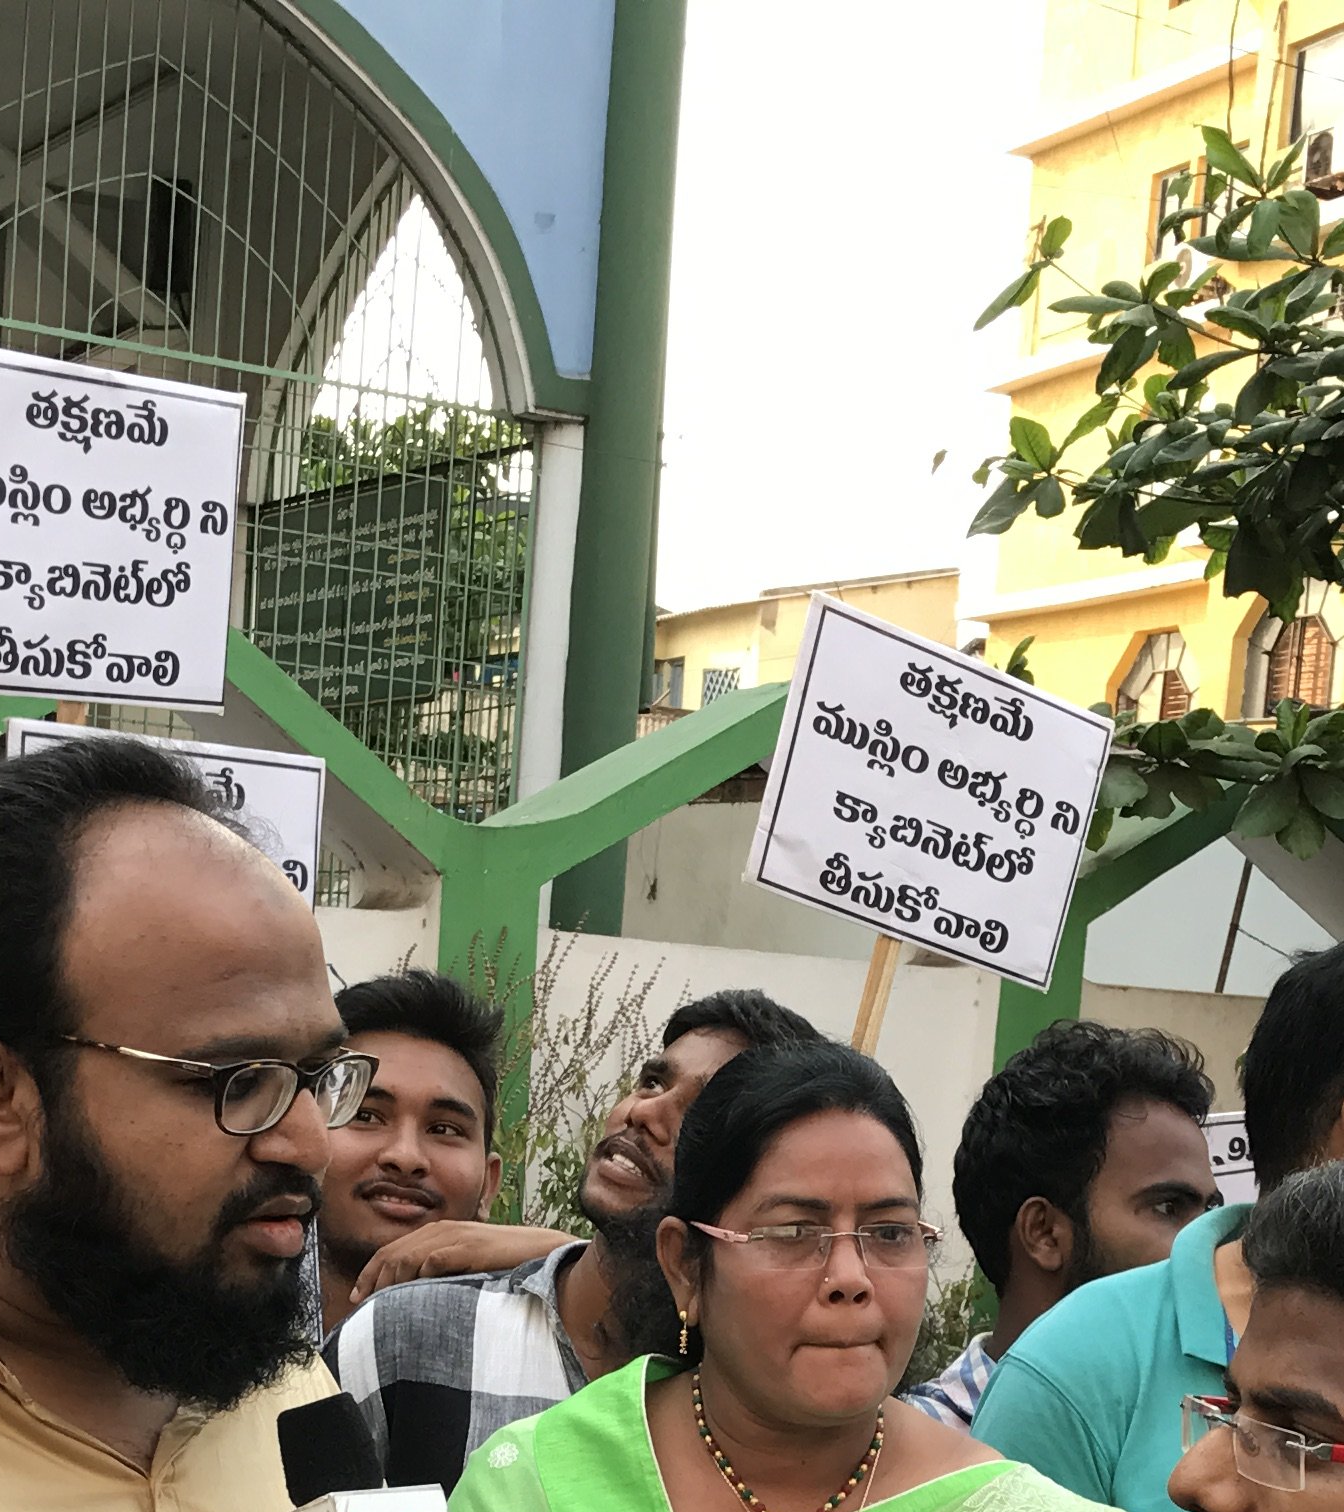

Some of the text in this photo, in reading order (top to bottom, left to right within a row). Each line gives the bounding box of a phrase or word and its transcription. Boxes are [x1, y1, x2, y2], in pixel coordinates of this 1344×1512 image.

[25, 390, 169, 454] తక్షణమే
[812, 701, 930, 778] ముస్లిం
[899, 662, 1034, 742] తక్షణమే
[819, 852, 1009, 954] తీసుకోవాలి
